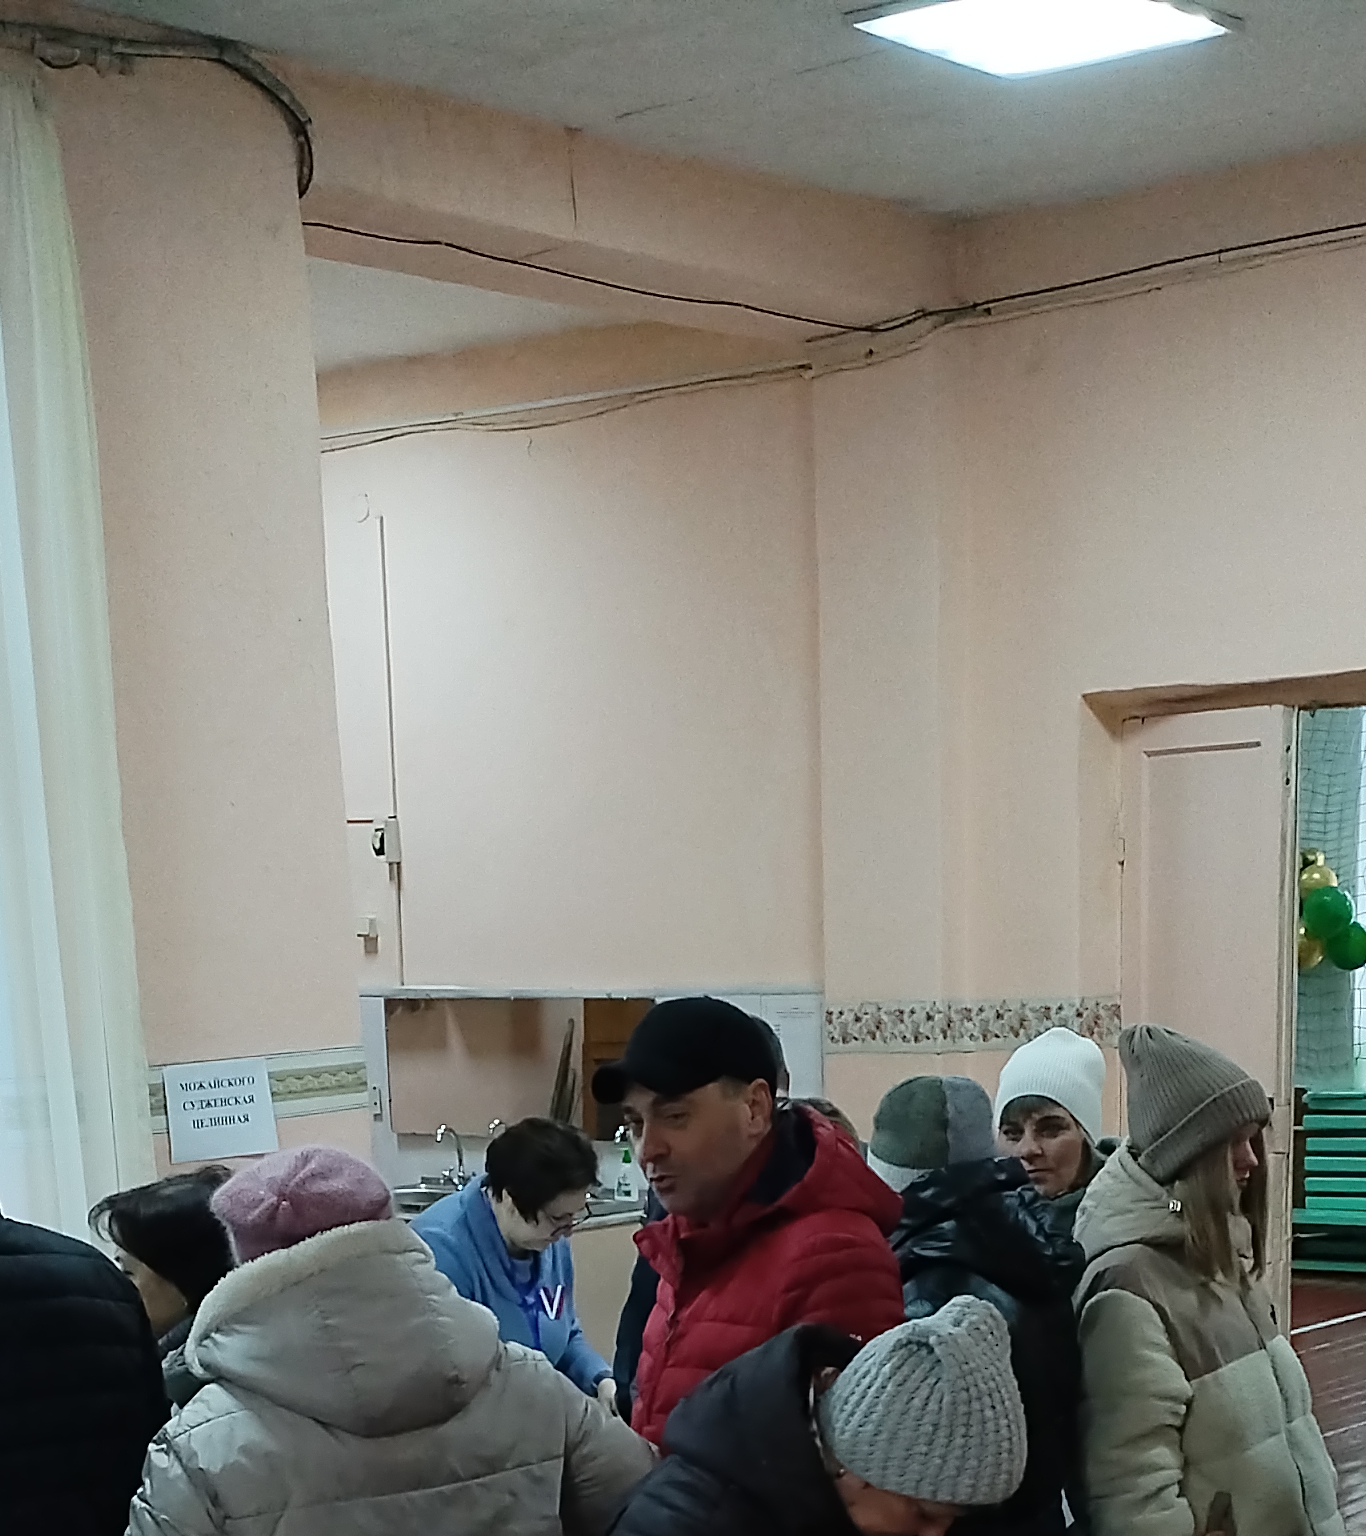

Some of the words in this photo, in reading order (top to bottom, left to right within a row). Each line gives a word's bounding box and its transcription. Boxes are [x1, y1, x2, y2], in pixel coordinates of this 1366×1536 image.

[179, 1075, 256, 1092] МОЖАЙСКОГО
[182, 1094, 256, 1112] СУДЖЕНСКАЯ
[192, 1113, 251, 1130] ЦЕЛИННАЯ
